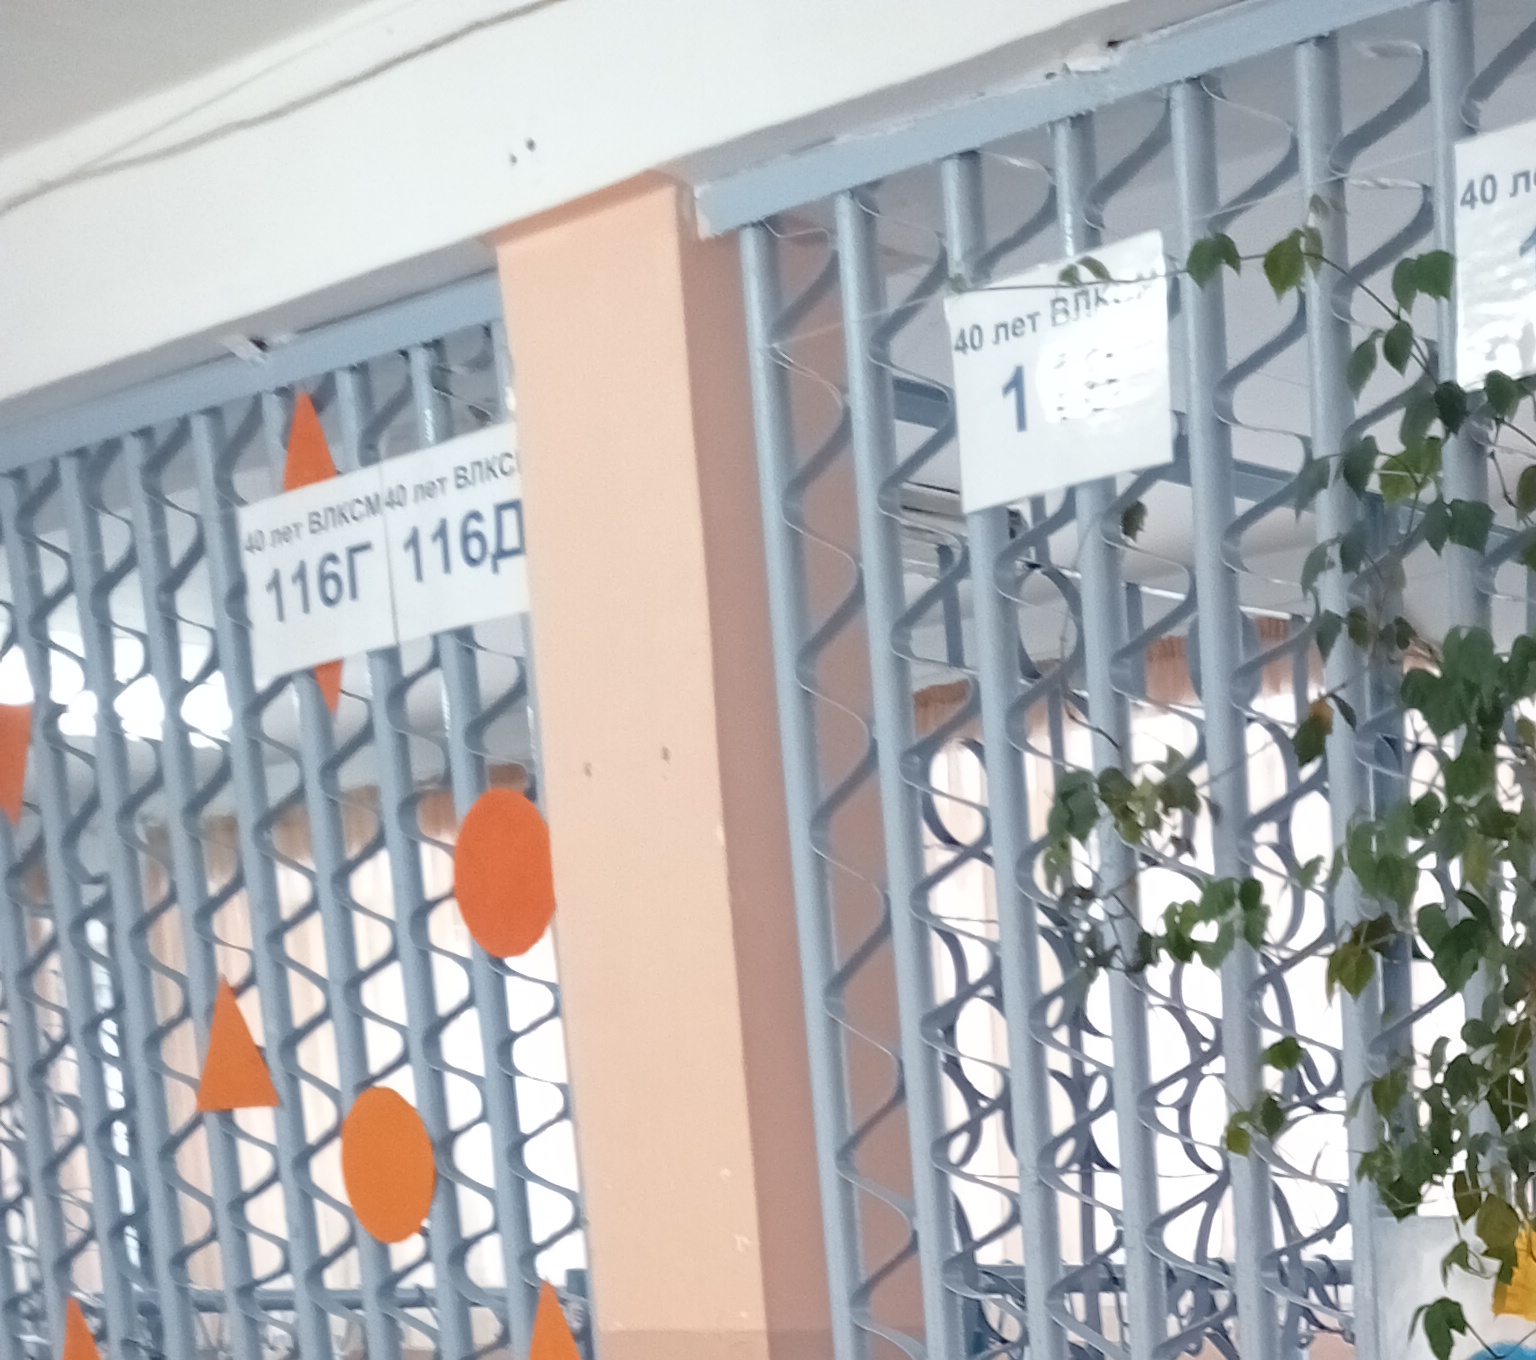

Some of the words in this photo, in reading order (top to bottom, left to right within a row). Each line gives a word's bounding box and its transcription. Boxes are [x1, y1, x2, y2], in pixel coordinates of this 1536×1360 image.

[1460, 174, 1498, 210] 40
[954, 324, 984, 354] 40
[992, 311, 1041, 345] лет
[384, 485, 407, 510] 40
[403, 499, 527, 584] 116Д
[265, 541, 373, 623] 116Г
